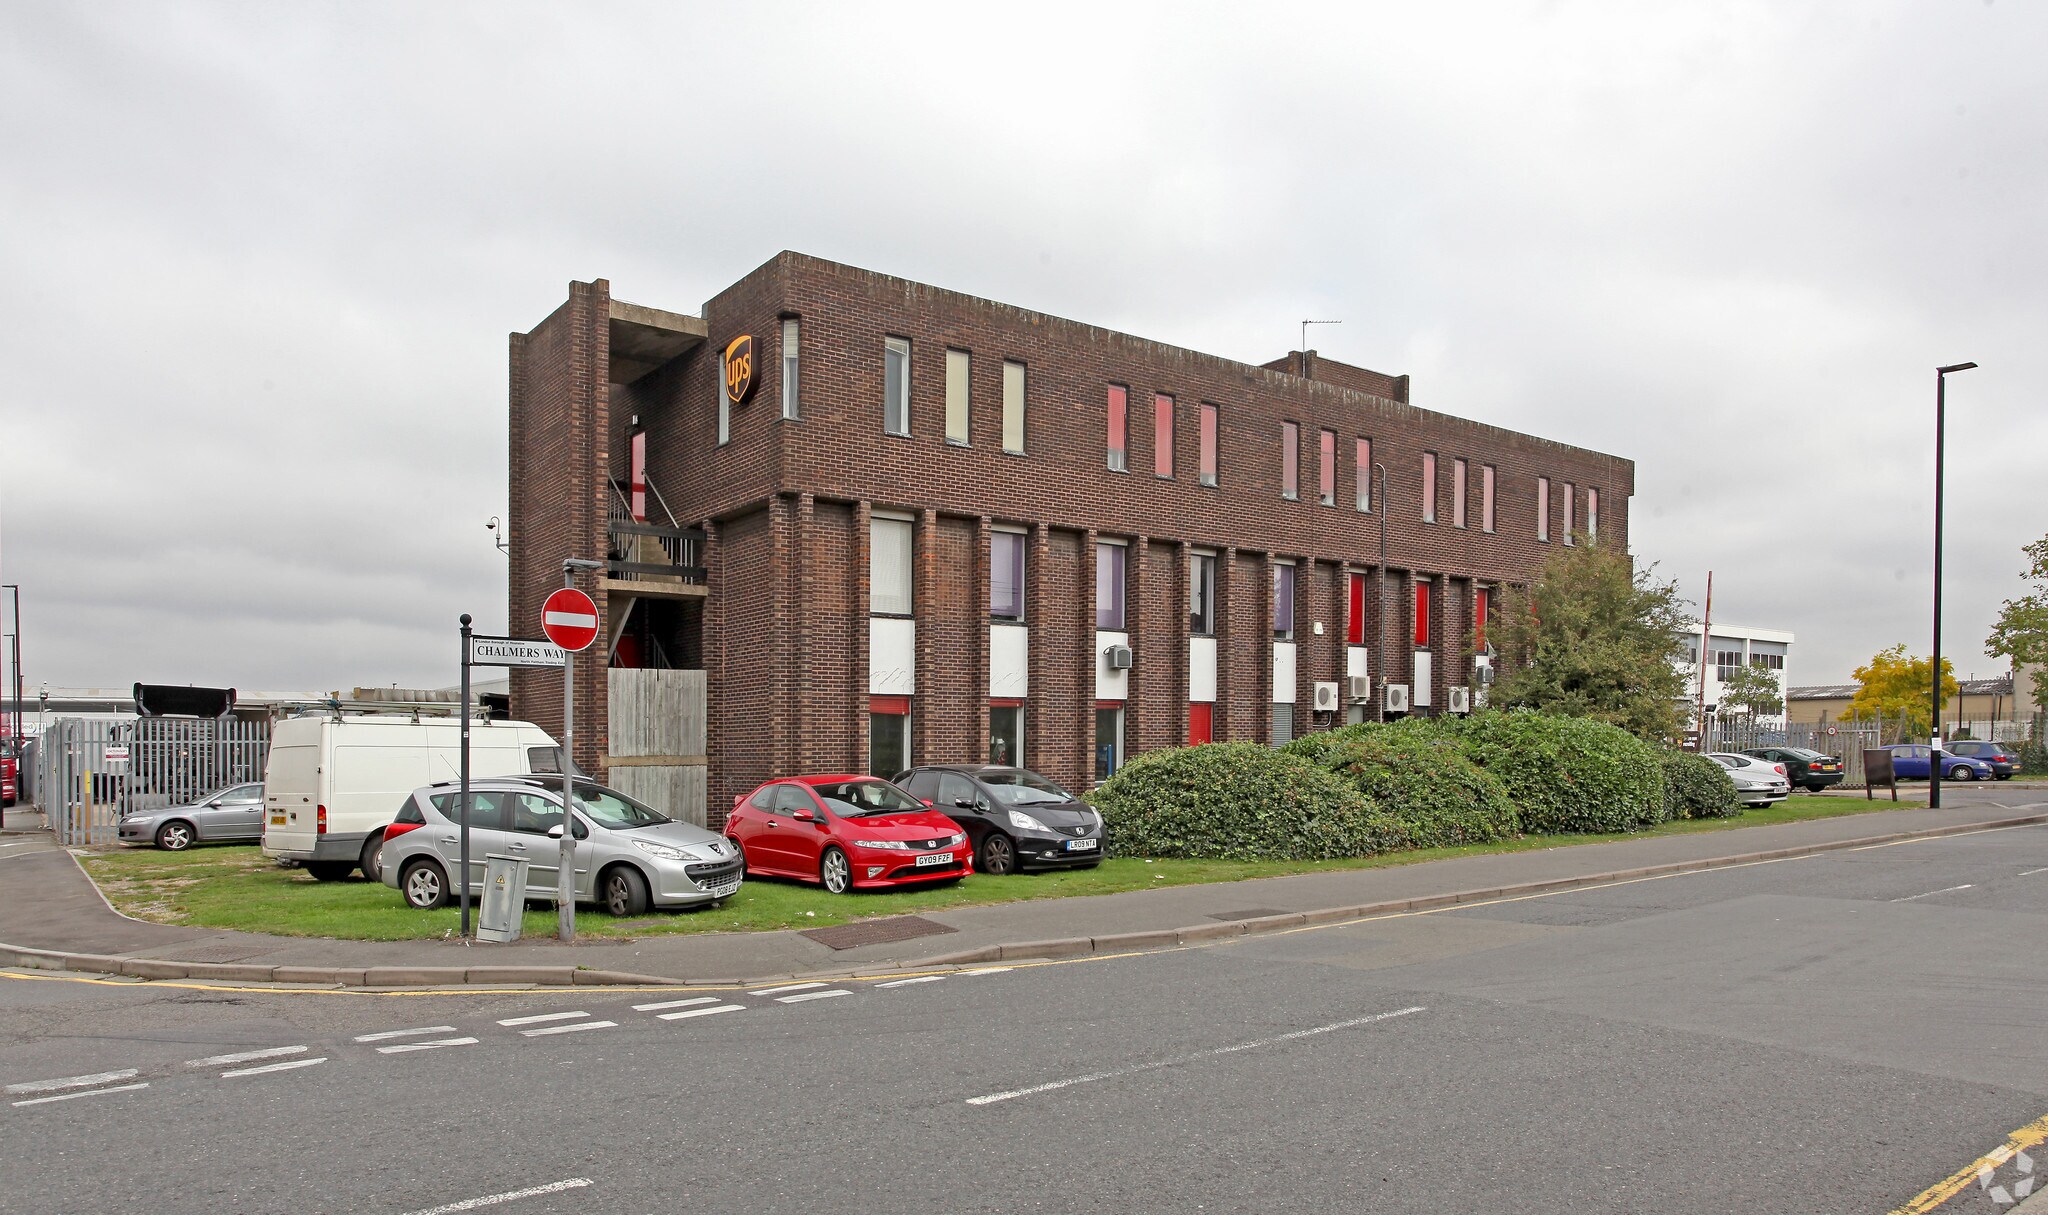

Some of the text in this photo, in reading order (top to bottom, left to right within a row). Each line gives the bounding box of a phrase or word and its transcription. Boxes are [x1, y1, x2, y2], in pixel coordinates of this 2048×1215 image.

[728, 353, 750, 394] ups
[477, 645, 565, 659] CHALMERS WAY
[919, 855, 937, 865] GY09
